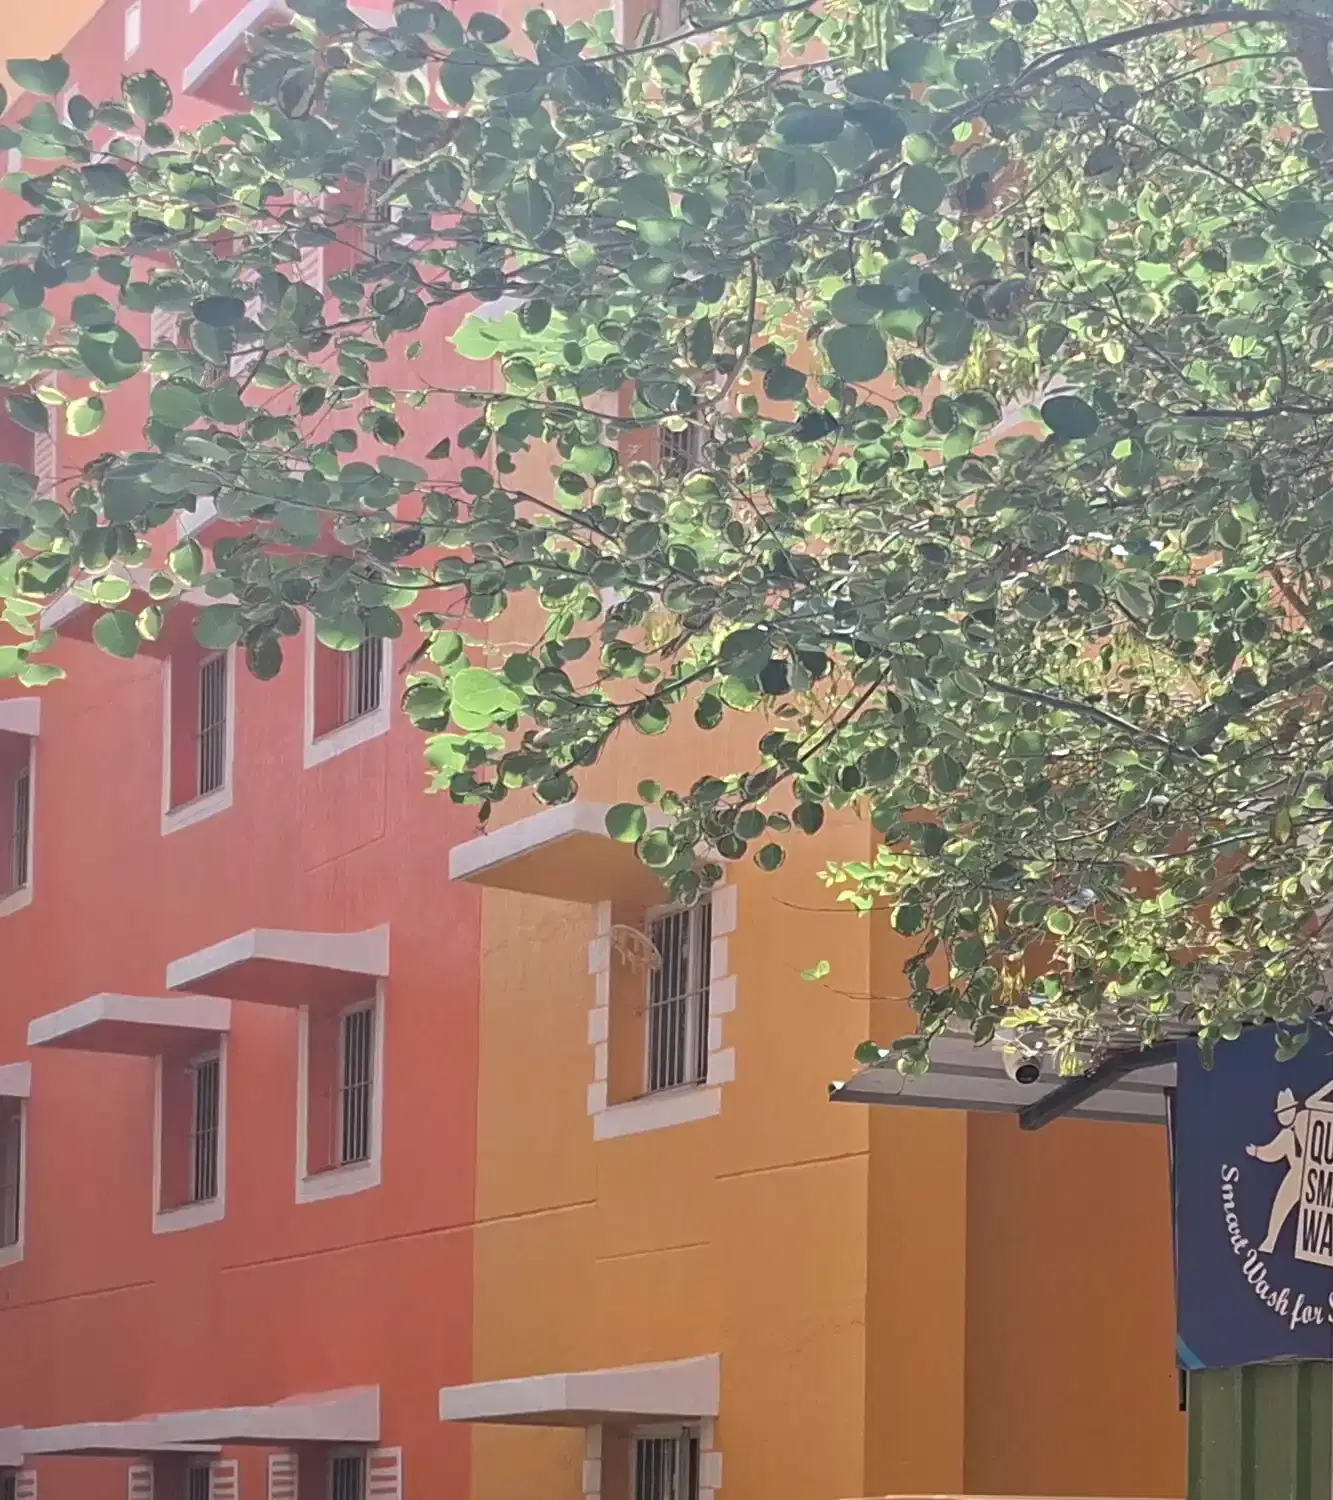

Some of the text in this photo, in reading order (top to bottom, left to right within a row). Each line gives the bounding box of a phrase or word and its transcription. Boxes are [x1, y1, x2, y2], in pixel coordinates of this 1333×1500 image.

[1221, 1163, 1324, 1330] Smart Wash for
